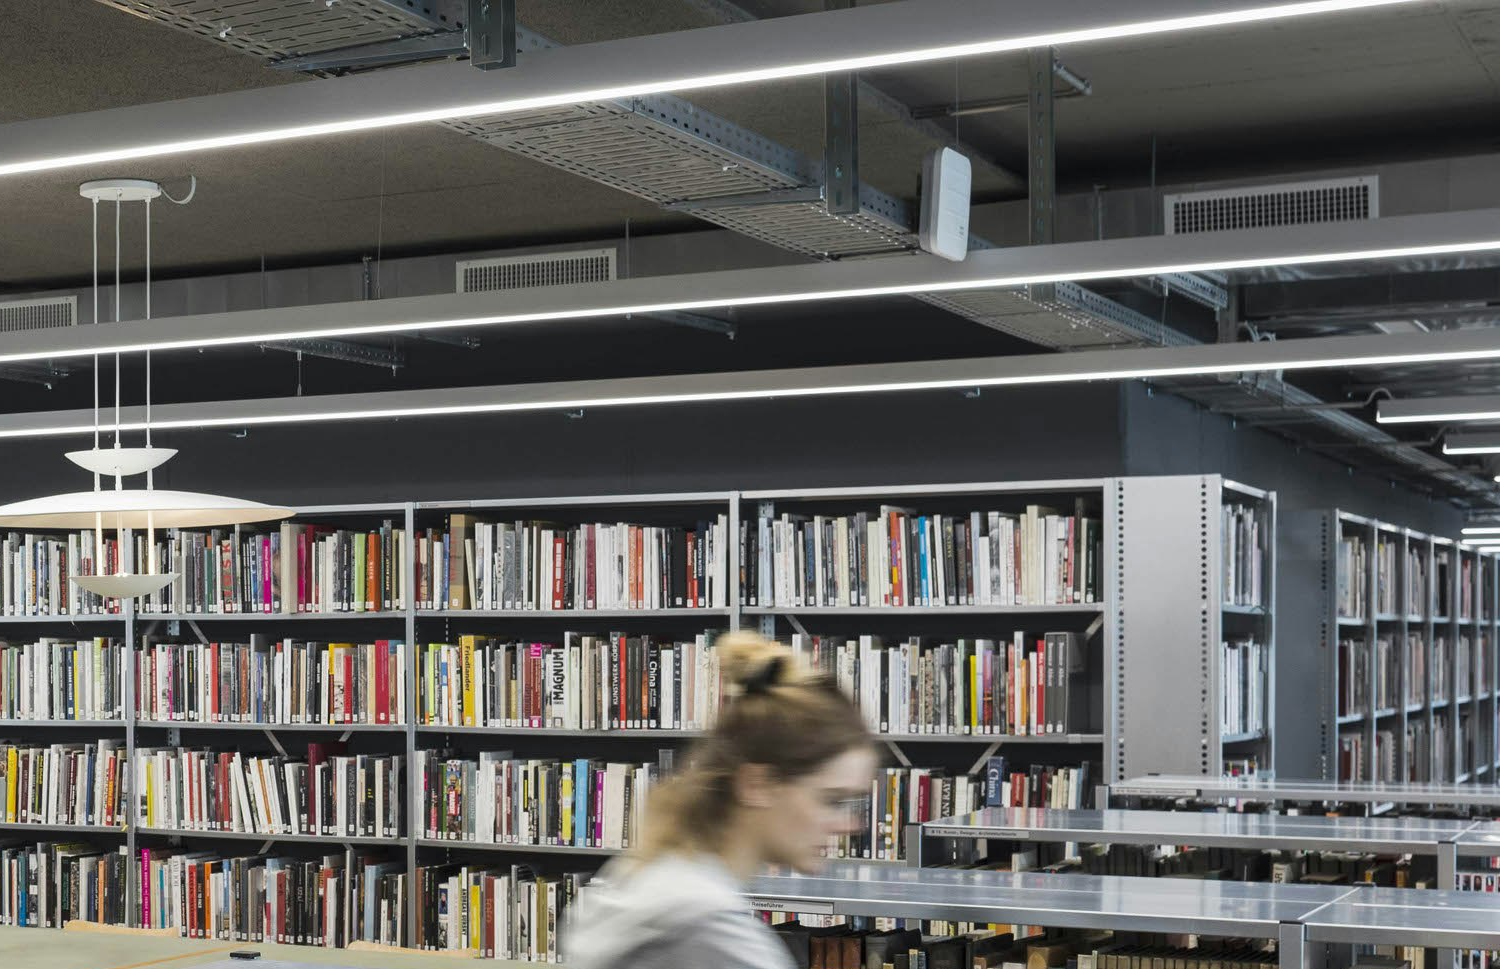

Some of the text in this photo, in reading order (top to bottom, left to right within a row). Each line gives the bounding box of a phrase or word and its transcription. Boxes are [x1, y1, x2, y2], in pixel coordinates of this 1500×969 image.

[553, 651, 564, 701] MAGNUM
[649, 661, 657, 688] China
[942, 782, 951, 800] RAY
[989, 768, 999, 798] China
